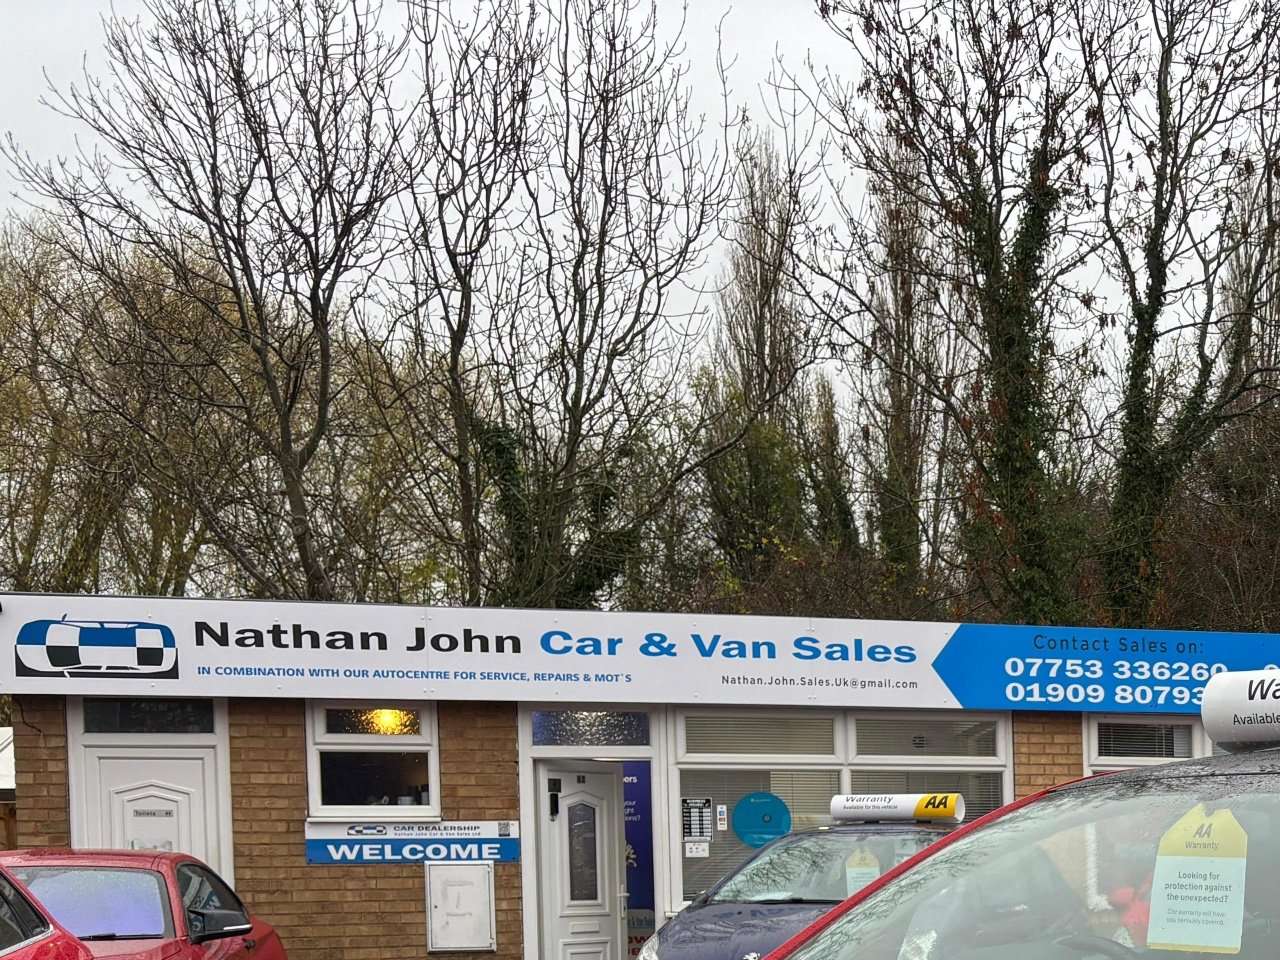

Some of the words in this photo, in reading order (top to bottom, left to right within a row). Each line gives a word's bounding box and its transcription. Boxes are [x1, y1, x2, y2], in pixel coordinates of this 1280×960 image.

[194, 621, 388, 651] Nathan
[406, 627, 522, 653] John
[540, 630, 623, 656] Car
[639, 632, 677, 657] &
[690, 634, 776, 659] Van
[792, 636, 917, 663] Sales
[1033, 634, 1109, 652] Contact
[1119, 637, 1168, 653] Sales
[197, 666, 211, 676] IN
[215, 666, 305, 677] COMBINATION
[308, 668, 340, 678] WITH
[343, 669, 369, 679] OUR
[372, 669, 450, 680] AUTOCENTRE
[454, 671, 477, 681] FOR
[480, 671, 530, 682] SERVICE,
[534, 672, 580, 682] REPAIRS
[583, 673, 592, 682] &
[1004, 657, 1103, 678] 07753
[721, 675, 918, 690] Nathan.John.Sales.Uk@gmail.com
[1005, 682, 1105, 703] 01909
[1114, 685, 1204, 705] 80793
[845, 796, 894, 804] Warranty
[924, 796, 948, 809] AA
[1193, 823, 1213, 839] AA
[326, 844, 501, 860] WELCOME
[1185, 841, 1219, 850] Warranty
[1178, 871, 1207, 881] Looking
[1209, 871, 1220, 881] for
[1164, 882, 1203, 891] protection
[1204, 884, 1232, 892] against
[1166, 893, 1179, 901] the
[1180, 894, 1229, 903] unexpected?
